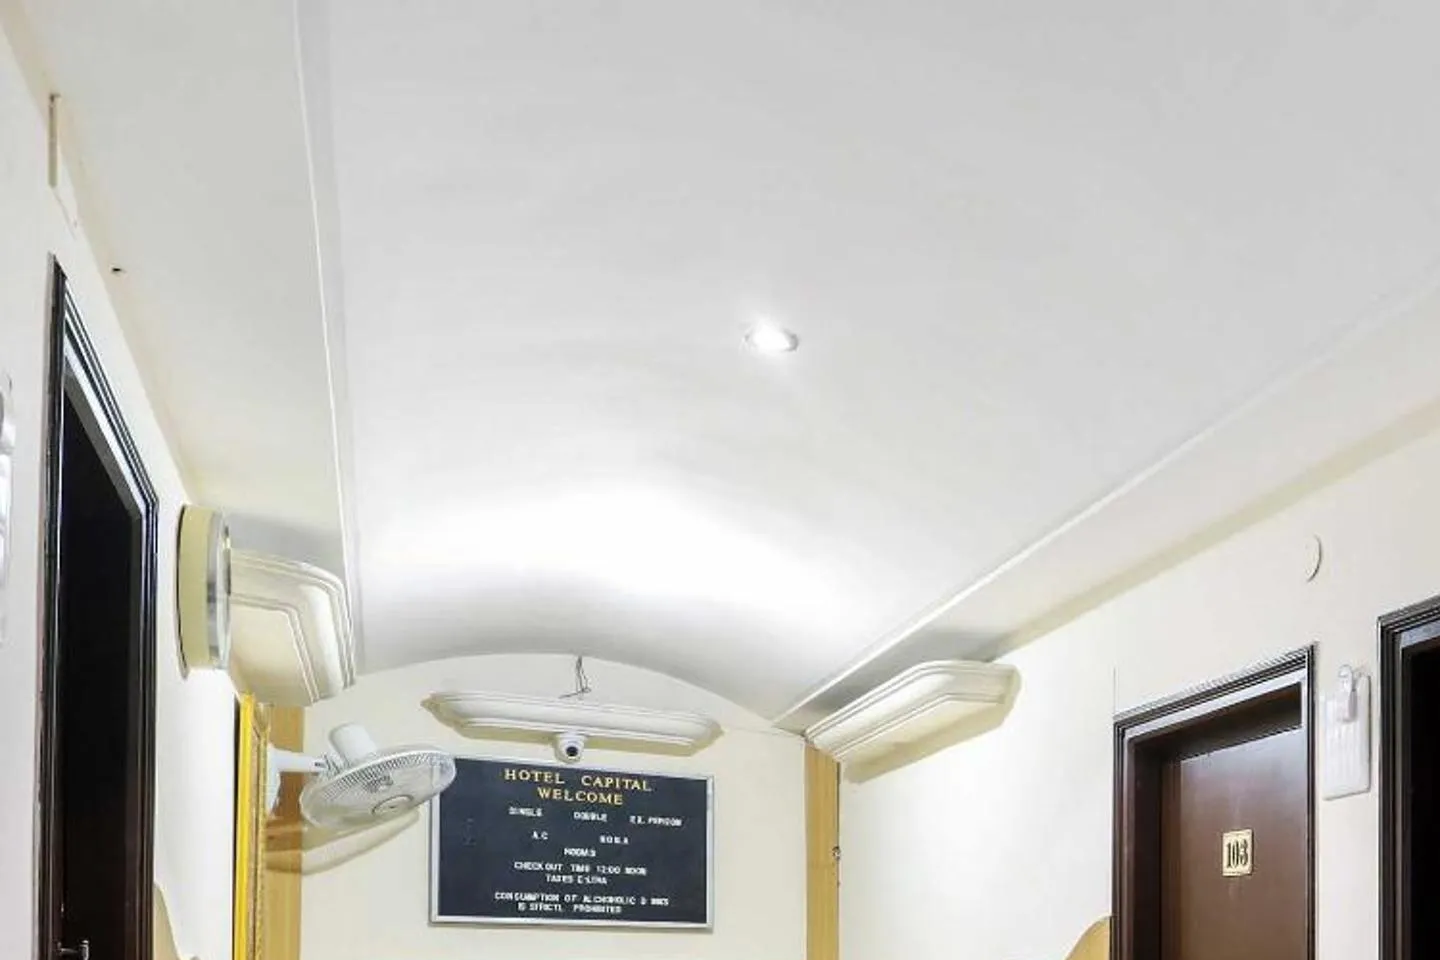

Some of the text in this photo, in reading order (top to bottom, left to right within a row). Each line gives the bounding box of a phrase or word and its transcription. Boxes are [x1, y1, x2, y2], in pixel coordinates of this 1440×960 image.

[505, 768, 652, 792] HOTEL CAPITAL
[537, 787, 624, 805] WELCOME
[1226, 838, 1249, 869] 103
